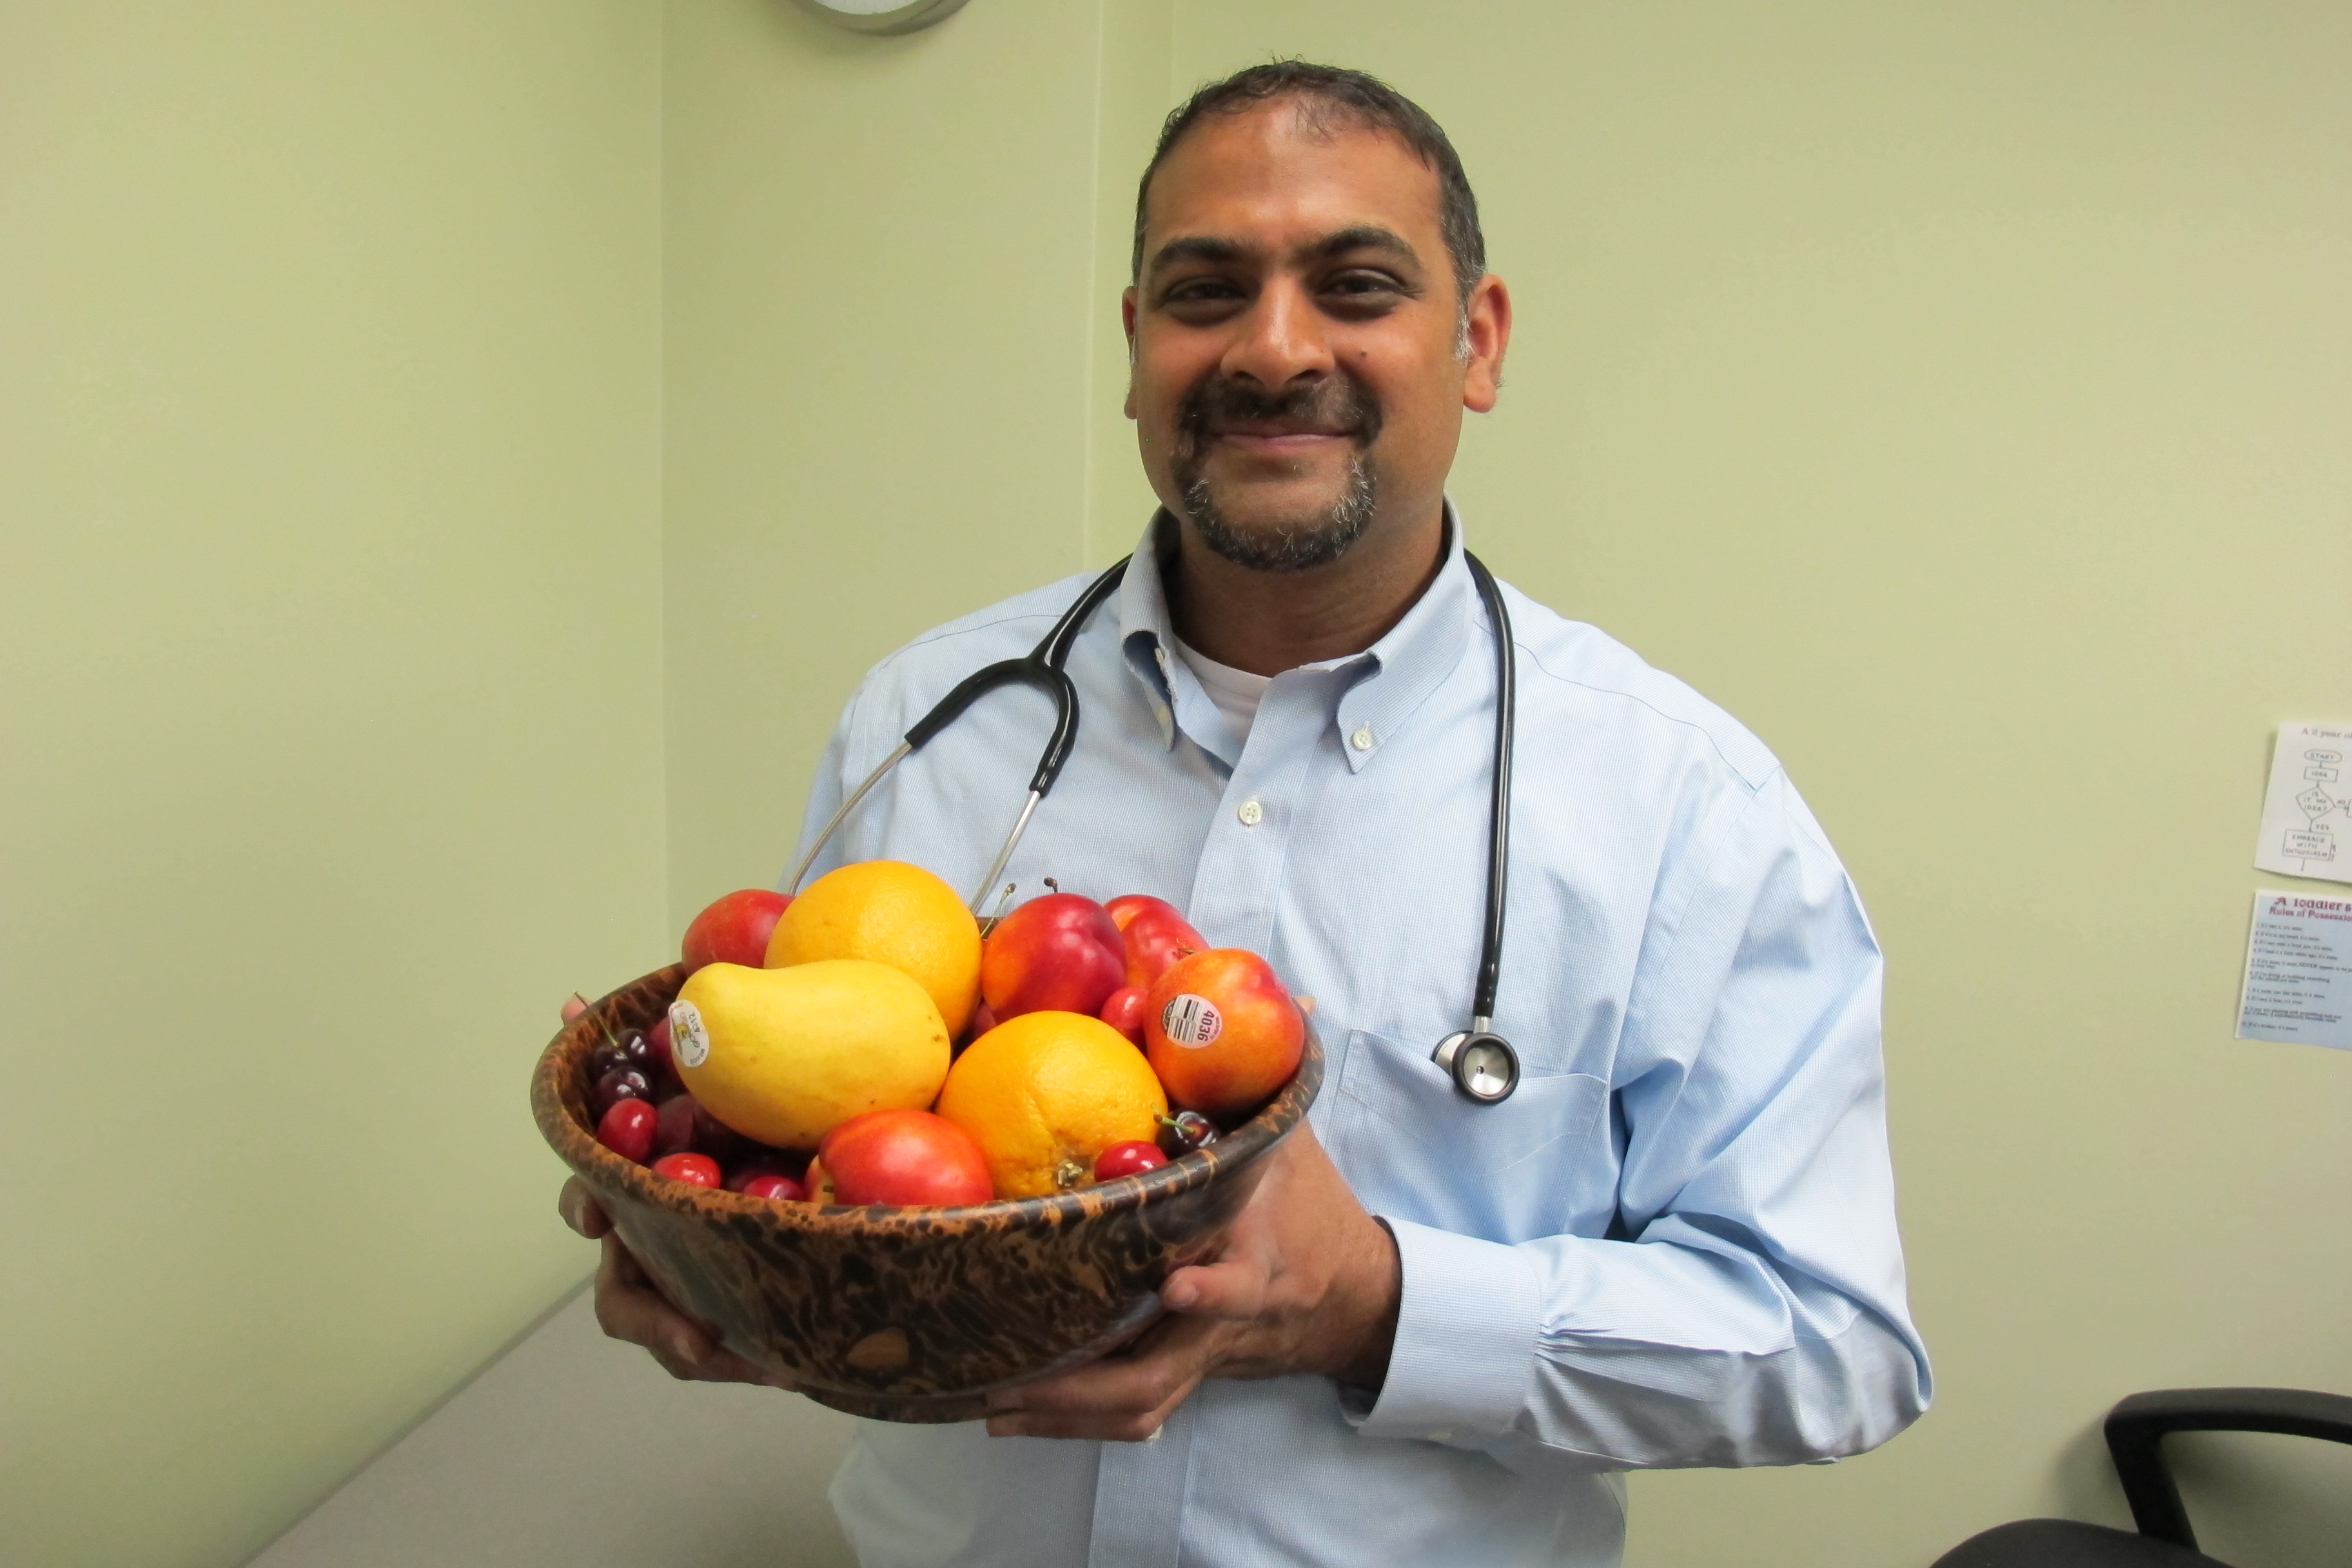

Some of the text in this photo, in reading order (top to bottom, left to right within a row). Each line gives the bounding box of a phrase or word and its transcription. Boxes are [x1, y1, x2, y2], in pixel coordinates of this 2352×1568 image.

[2275, 897, 2287, 905] A
[2269, 906, 2294, 916] Rules
[2297, 909, 2306, 917] of
[1197, 1010, 1215, 1042] 4036
